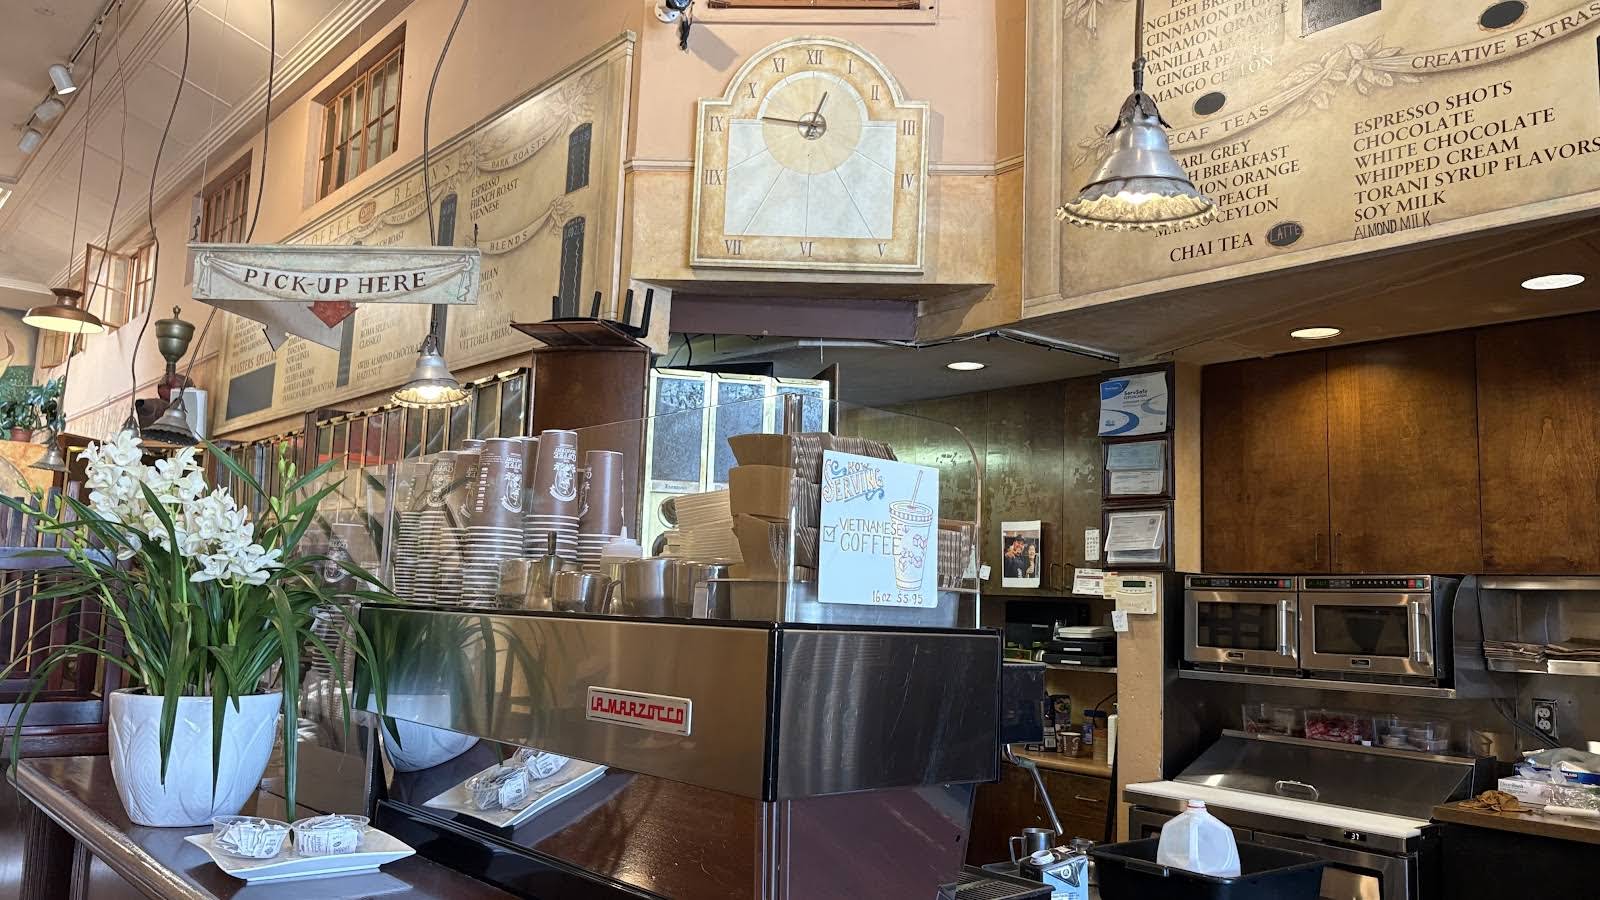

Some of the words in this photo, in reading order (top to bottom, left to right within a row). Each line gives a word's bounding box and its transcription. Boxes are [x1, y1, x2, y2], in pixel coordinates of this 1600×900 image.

[1146, 7, 1229, 47] CINNAMON
[1223, 2, 1289, 35] ORANGE
[1411, 40, 1507, 69] CREATIVE
[1515, 3, 1600, 49] EXTRAS
[772, 57, 785, 73] XI
[806, 49, 824, 65] XII
[847, 59, 853, 75] I
[1147, 47, 1205, 76] VANILLA
[1156, 60, 1210, 88] GINGER
[748, 82, 757, 99] X
[870, 84, 881, 101] II
[1152, 78, 1207, 104] MANGO
[1353, 100, 1440, 136] ESPRESSO
[1445, 80, 1513, 111] SHOTS
[709, 116, 723, 132] IX
[902, 119, 916, 136] III
[1168, 127, 1210, 146] ECAF
[1221, 104, 1269, 132] TEAS
[1352, 109, 1476, 153] CHOCOLATE
[1354, 142, 1418, 170] WHITE
[1422, 107, 1556, 152] CHOCOLATE
[1175, 152, 1208, 170] ARL
[1210, 139, 1252, 161] GREY
[1203, 145, 1290, 179] BREAKFAST
[1354, 155, 1440, 187] WHIPPED
[1446, 136, 1520, 166] CREAM
[705, 169, 723, 186] IIX
[900, 173, 915, 190] IV
[1232, 159, 1300, 187] ORANGE
[1354, 176, 1429, 205] TORANI
[1434, 160, 1499, 188] SYRUP
[1504, 137, 1600, 173] FLAVORS
[1218, 183, 1269, 207] PEACH
[1354, 204, 1390, 223] SOY
[1396, 190, 1447, 215] MILK
[1215, 198, 1279, 224] CEYLON
[1269, 223, 1301, 242] LATTE
[1353, 219, 1398, 240] ALMOND
[1399, 210, 1432, 232] MILK
[489, 230, 528, 251] BLENDS
[725, 239, 742, 256] VII
[800, 241, 813, 257] VI
[877, 243, 888, 257] V
[1169, 240, 1213, 263] CHAI
[1218, 232, 1254, 252] TEA
[243, 268, 349, 295] PICK-UP
[358, 271, 427, 294] HERE
[1124, 388, 1148, 396] ServSafe
[823, 459, 884, 503] SERVING
[839, 517, 904, 537] VIETNAMESE
[840, 532, 905, 556] COFFEE
[872, 589, 891, 603] 16oz
